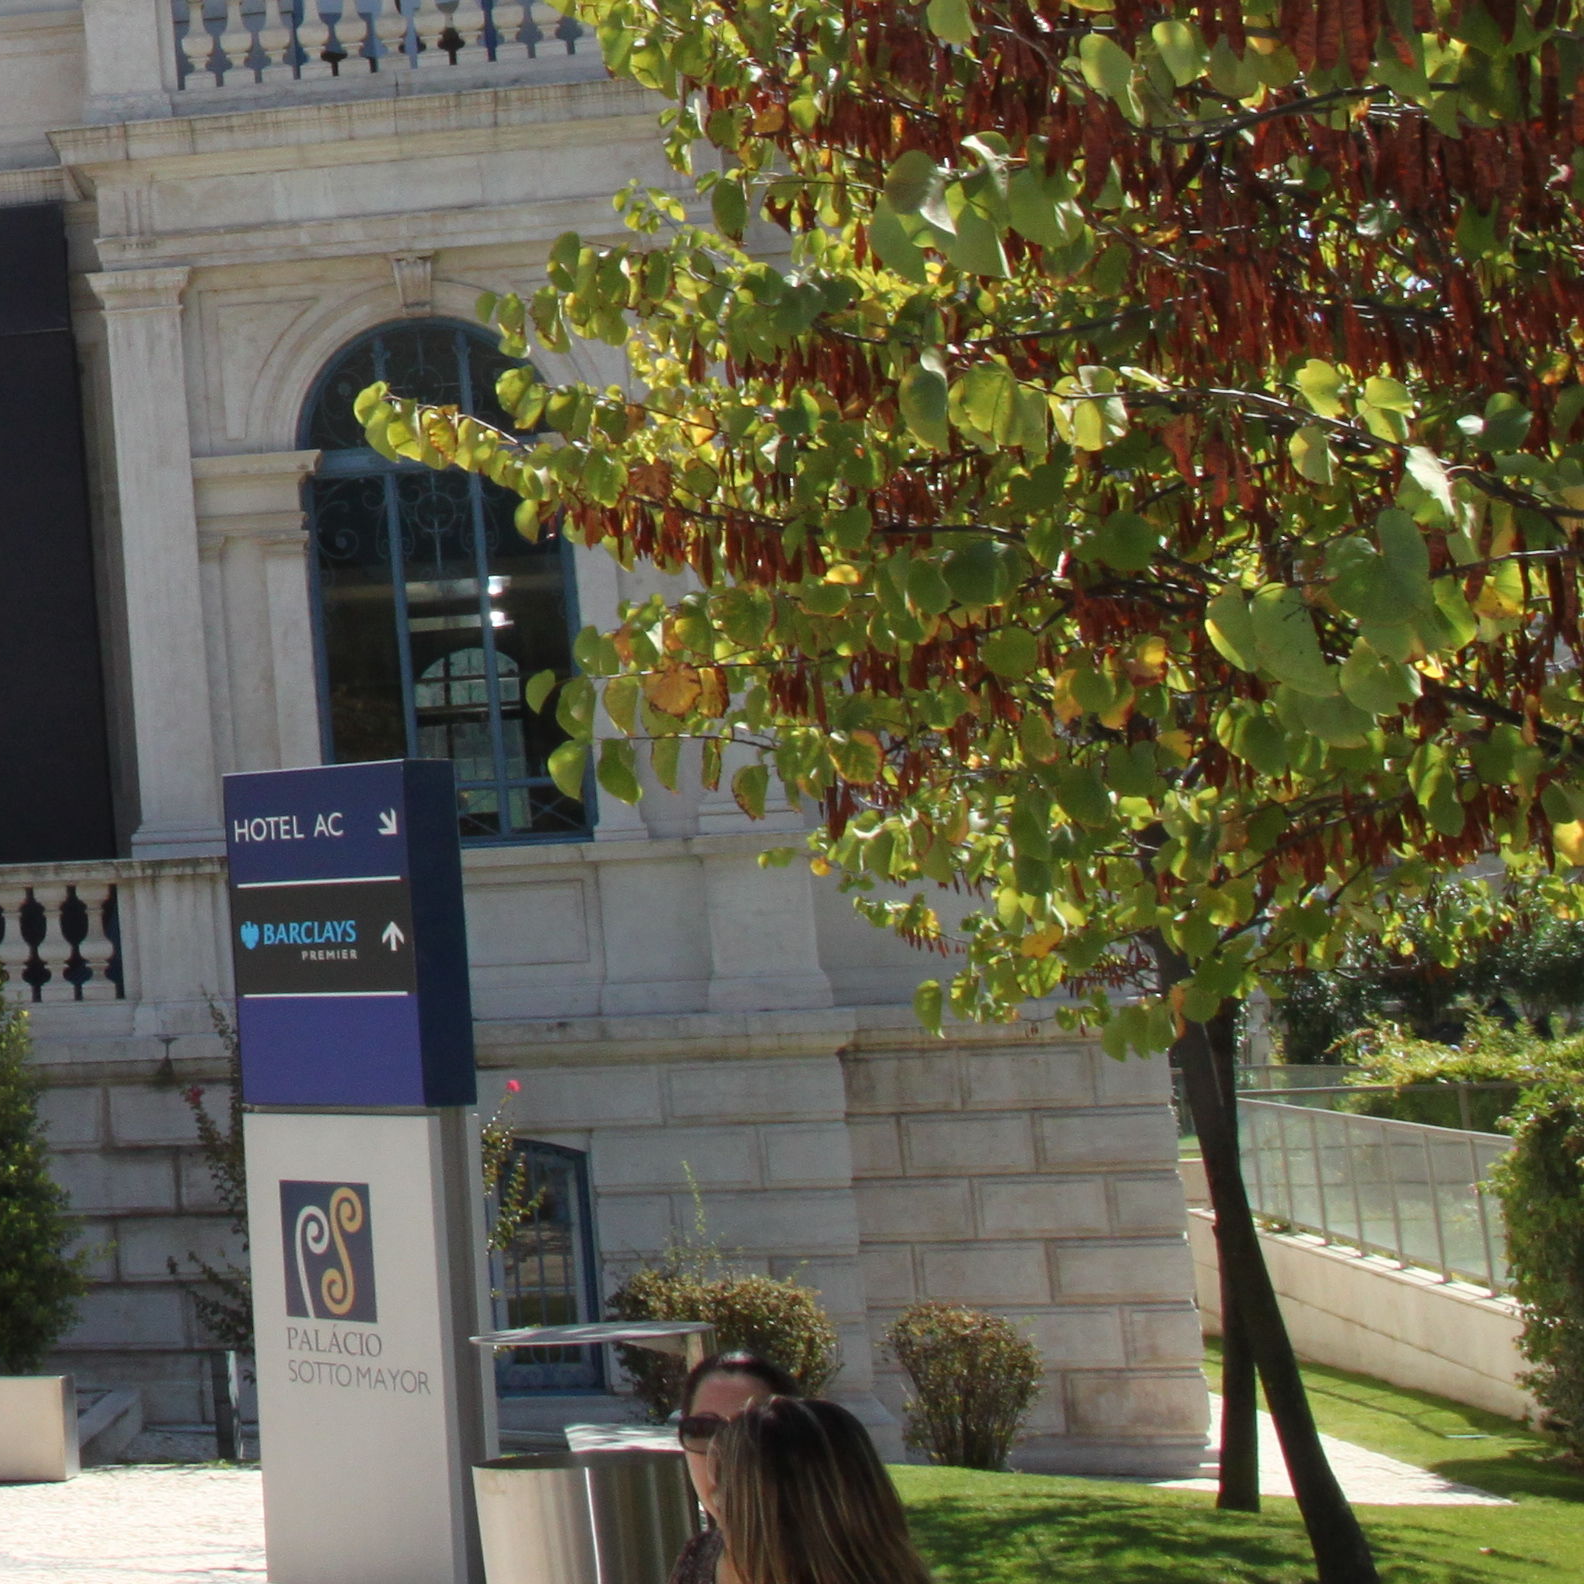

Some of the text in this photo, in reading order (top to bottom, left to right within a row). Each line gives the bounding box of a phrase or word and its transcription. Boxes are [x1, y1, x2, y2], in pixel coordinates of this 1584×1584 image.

[234, 812, 344, 843] HOTEL AC
[263, 920, 357, 944] BARCLAYS
[301, 949, 358, 961] PREMIER
[286, 1323, 382, 1358] PALÁCIO
